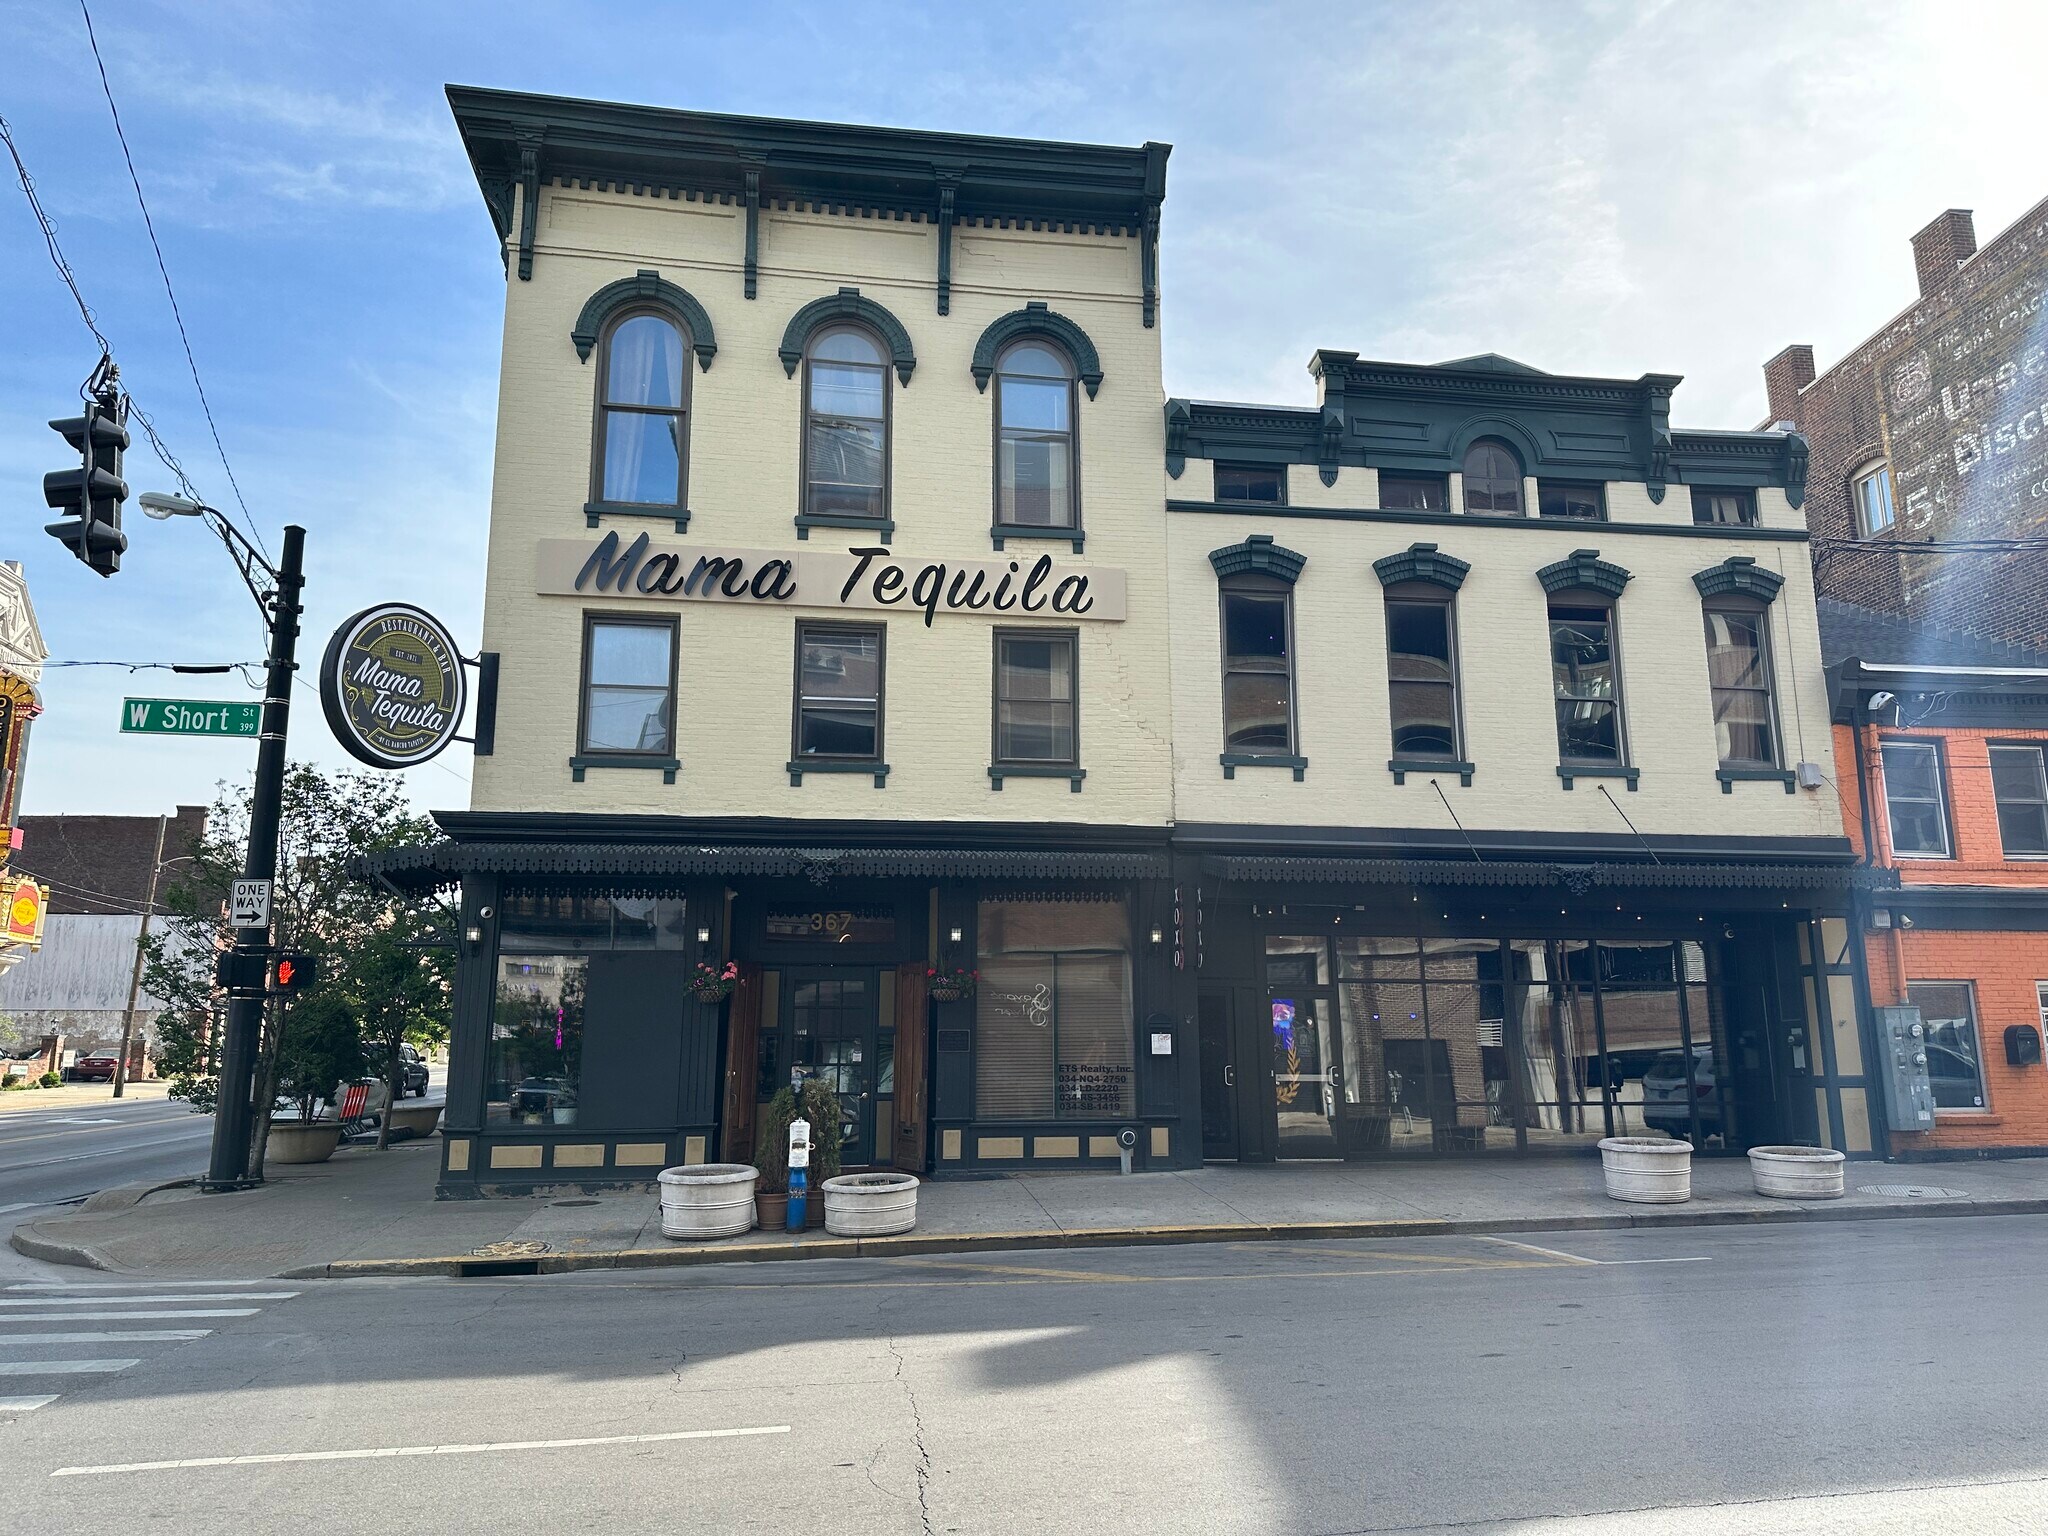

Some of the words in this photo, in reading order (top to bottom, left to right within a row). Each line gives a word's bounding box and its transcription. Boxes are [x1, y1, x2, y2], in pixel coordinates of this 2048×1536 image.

[574, 531, 796, 600] Mama
[840, 547, 1094, 628] Tequila
[381, 619, 435, 645] RESTAURANT
[433, 644, 441, 653] &
[438, 653, 452, 674] BAR
[353, 656, 422, 698] Mama
[130, 703, 150, 728] W
[162, 705, 229, 731] Short
[243, 707, 254, 717] St
[371, 688, 444, 731] Tequila
[239, 722, 254, 732] 399
[238, 884, 265, 895] ONE
[236, 897, 265, 908] WAY
[811, 912, 852, 931] 367
[538, 961, 575, 975] Modelo
[1058, 1064, 1077, 1073] ETS
[1081, 1065, 1114, 1074] Realty,
[1116, 1065, 1134, 1073] Inc.
